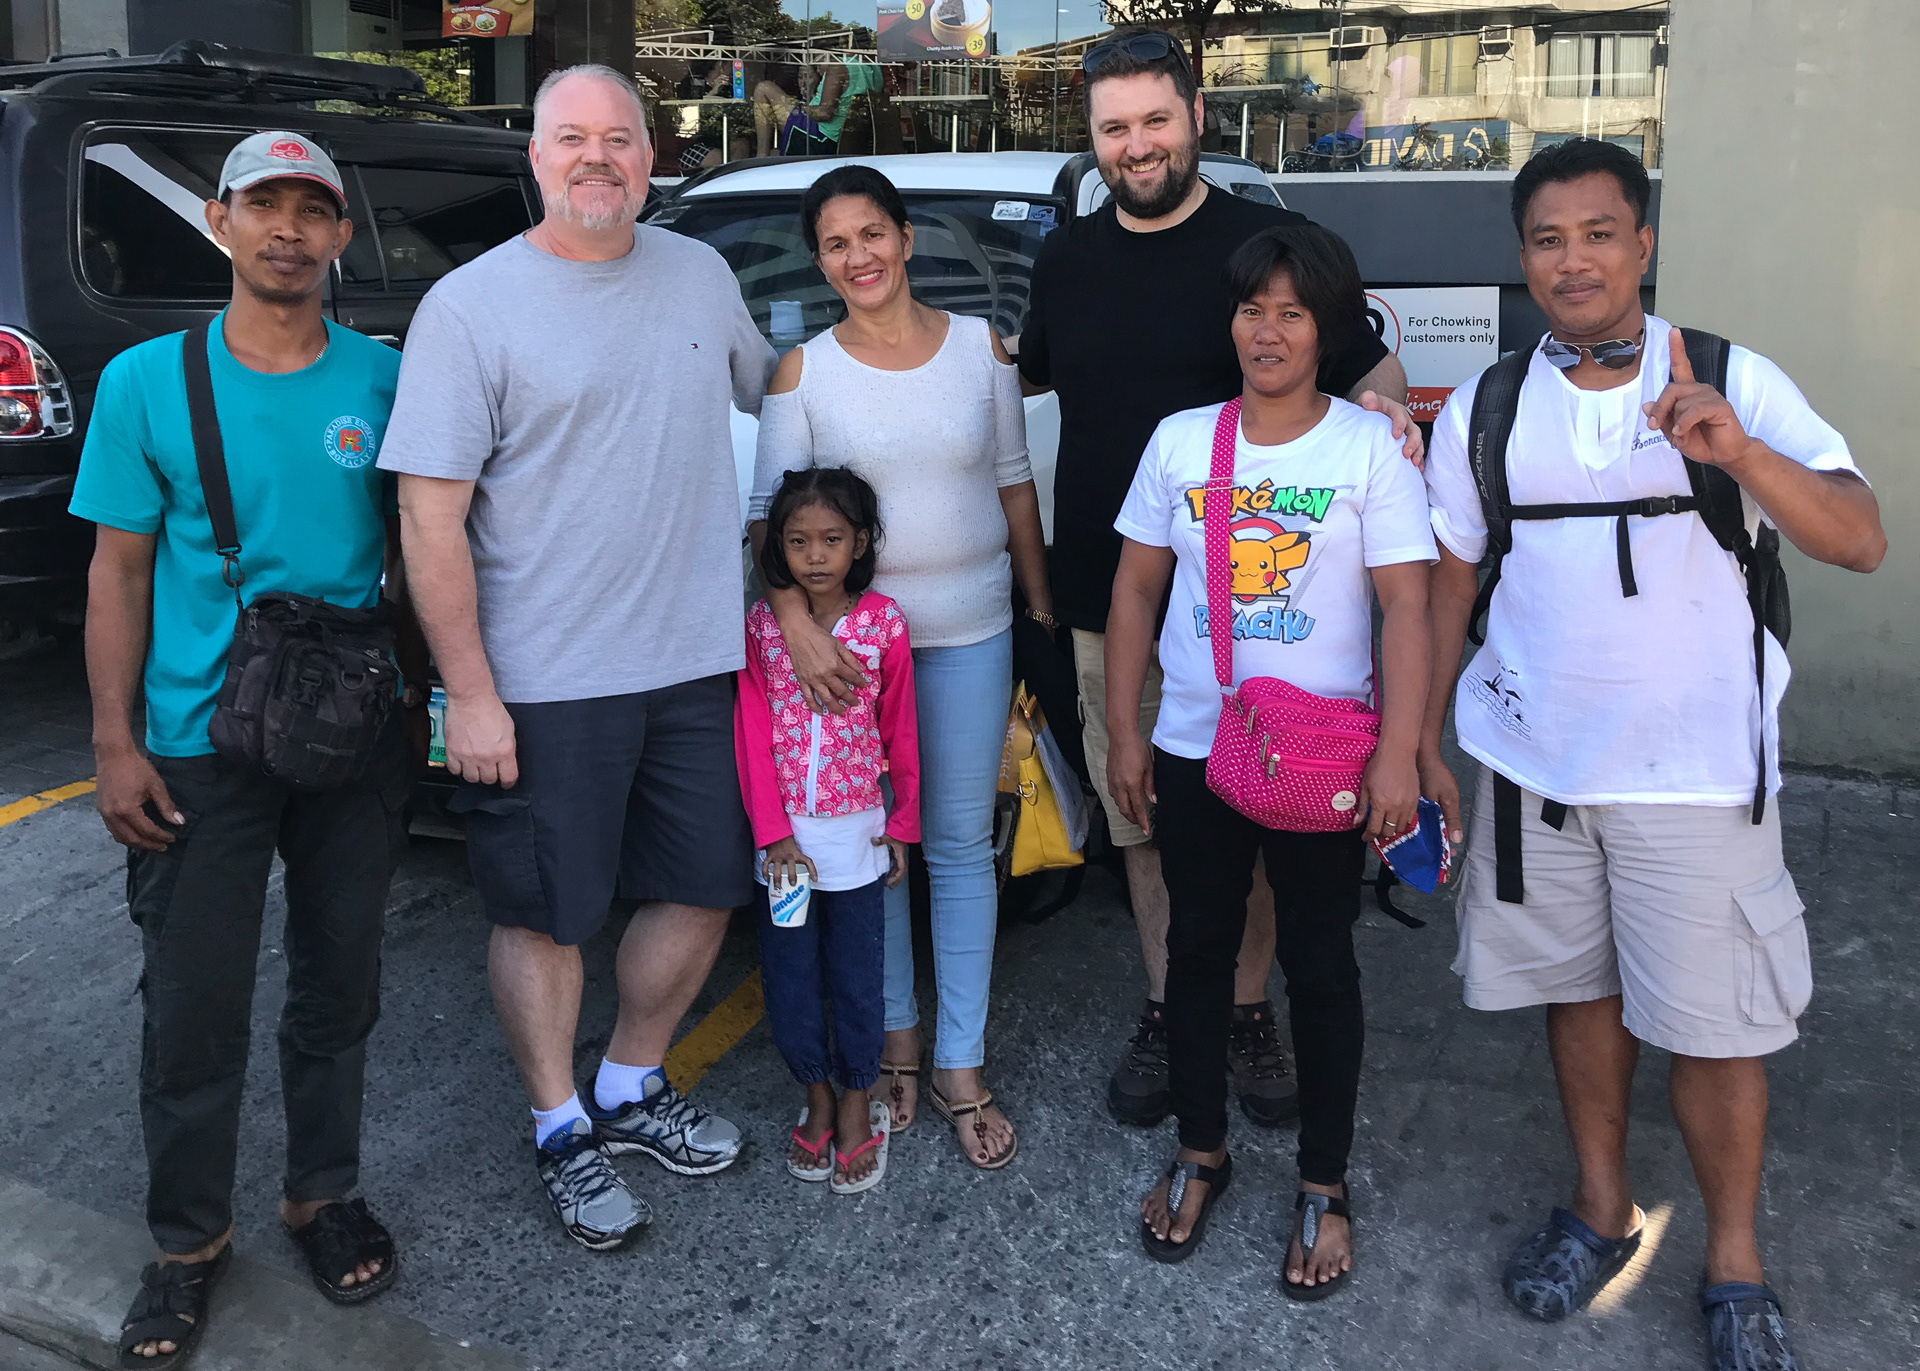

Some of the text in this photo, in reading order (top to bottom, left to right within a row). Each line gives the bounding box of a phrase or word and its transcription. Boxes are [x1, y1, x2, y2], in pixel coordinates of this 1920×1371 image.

[1408, 316, 1491, 329] For Chowking
[1403, 332, 1495, 345] customers only
[1405, 392, 1442, 417] king
[330, 449, 370, 466] BORACAY
[1193, 604, 1316, 644] PACHU
